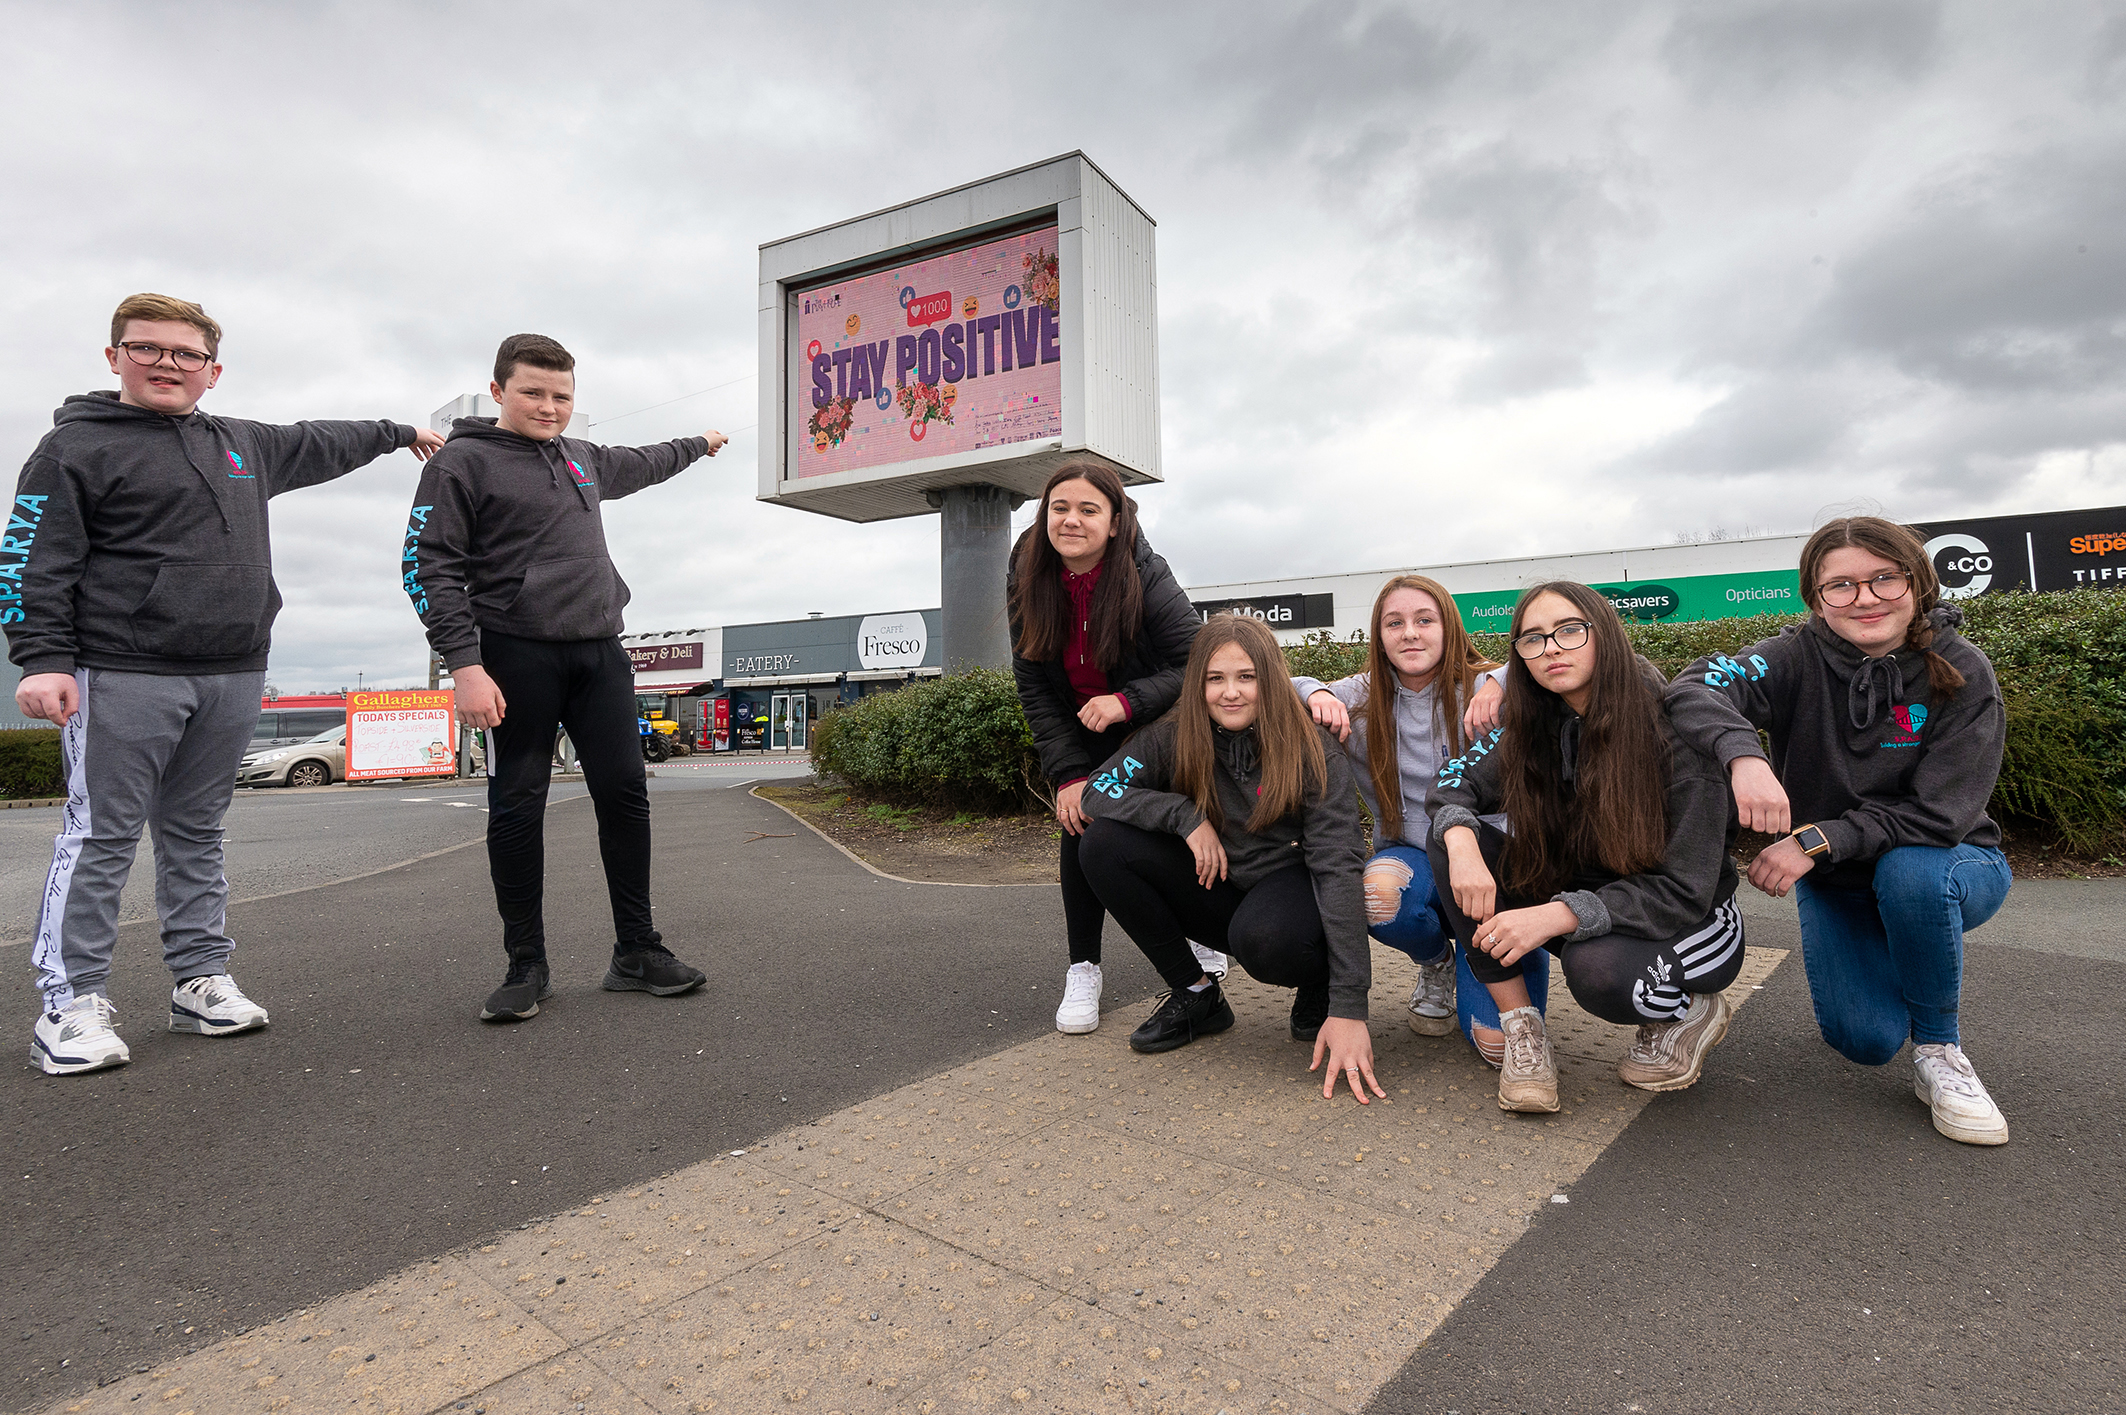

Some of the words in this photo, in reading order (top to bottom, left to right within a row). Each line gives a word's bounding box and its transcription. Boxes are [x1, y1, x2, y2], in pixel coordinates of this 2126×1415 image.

[922, 298, 948, 316] 1000
[812, 339, 889, 409] STAY
[896, 304, 1061, 387] POSITIVE
[0, 494, 49, 624] S.P.A.R.Y.A
[2072, 567, 2126, 581] TIFF
[1607, 595, 1670, 609] ecsavers
[1726, 587, 1791, 603] Opticians
[1233, 604, 1293, 623] Moda
[1472, 604, 1515, 618] Audiolo
[660, 646, 670, 659] &
[671, 645, 693, 659] Deli
[863, 635, 921, 657] Fresco
[353, 693, 449, 708] Gallaghers
[357, 713, 397, 722] TODAYS
[398, 711, 445, 721] SPECIALS
[397, 721, 441, 734] SILVERSIDE
